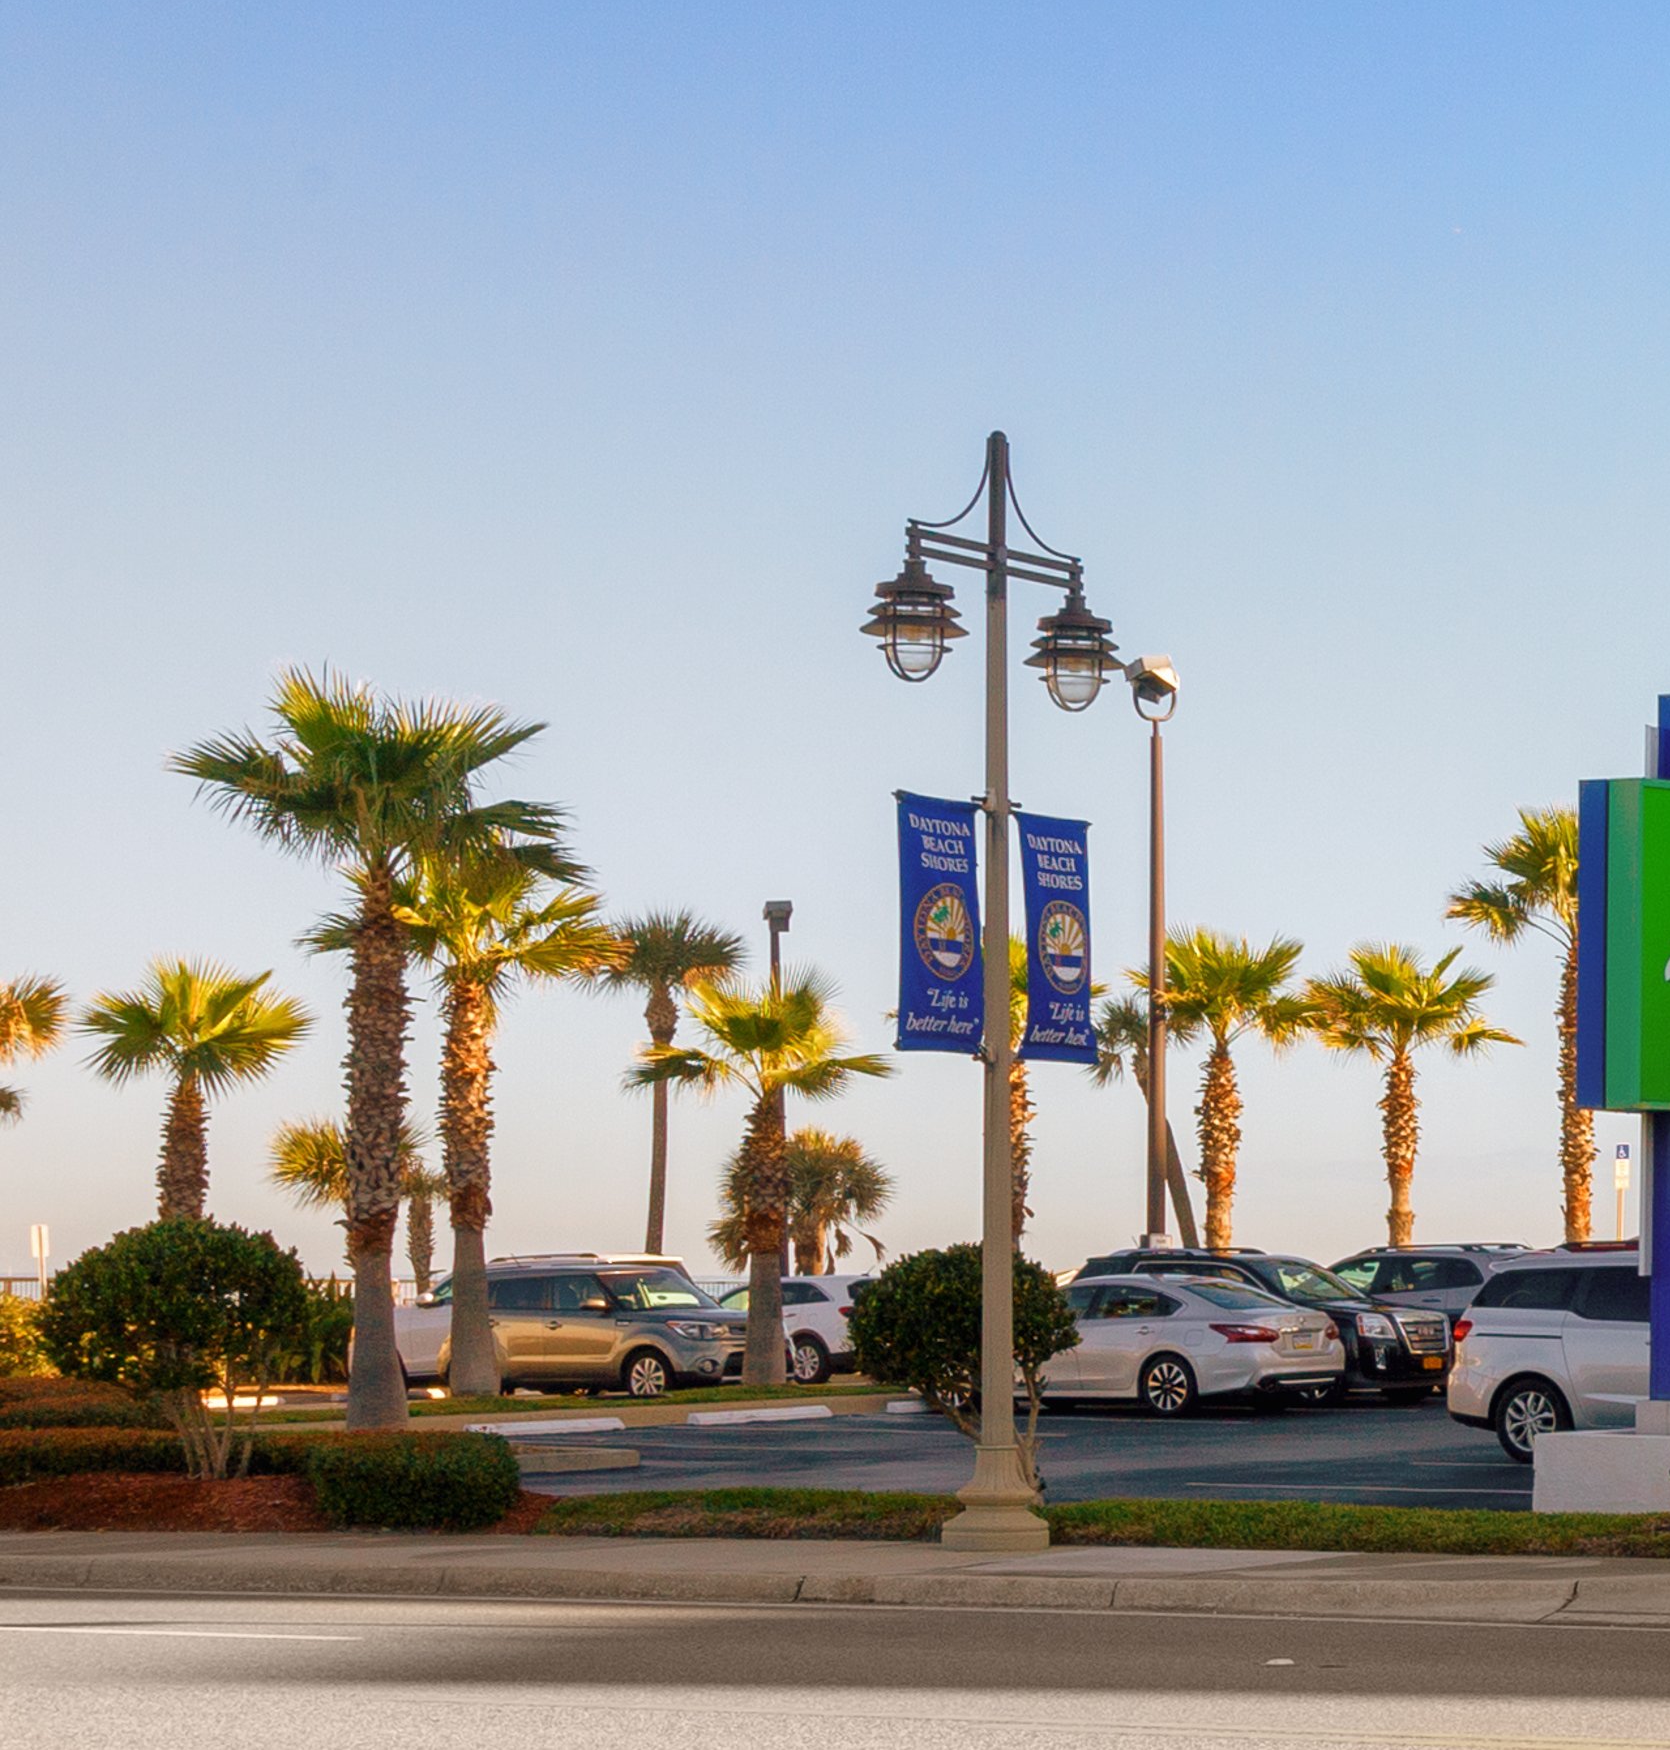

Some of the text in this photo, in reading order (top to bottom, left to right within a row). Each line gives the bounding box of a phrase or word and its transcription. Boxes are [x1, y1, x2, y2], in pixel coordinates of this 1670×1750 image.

[908, 813, 971, 837] DAYTONA
[921, 835, 965, 855] BEACH
[1026, 833, 1083, 855] DAYTONA
[920, 852, 969, 873] SHORES
[1037, 853, 1076, 872] BEACH
[1037, 871, 1083, 891] SHORES
[958, 991, 969, 1009] is
[906, 1012, 948, 1032] better
[1075, 1004, 1085, 1022] is
[1029, 1024, 1065, 1043] better
